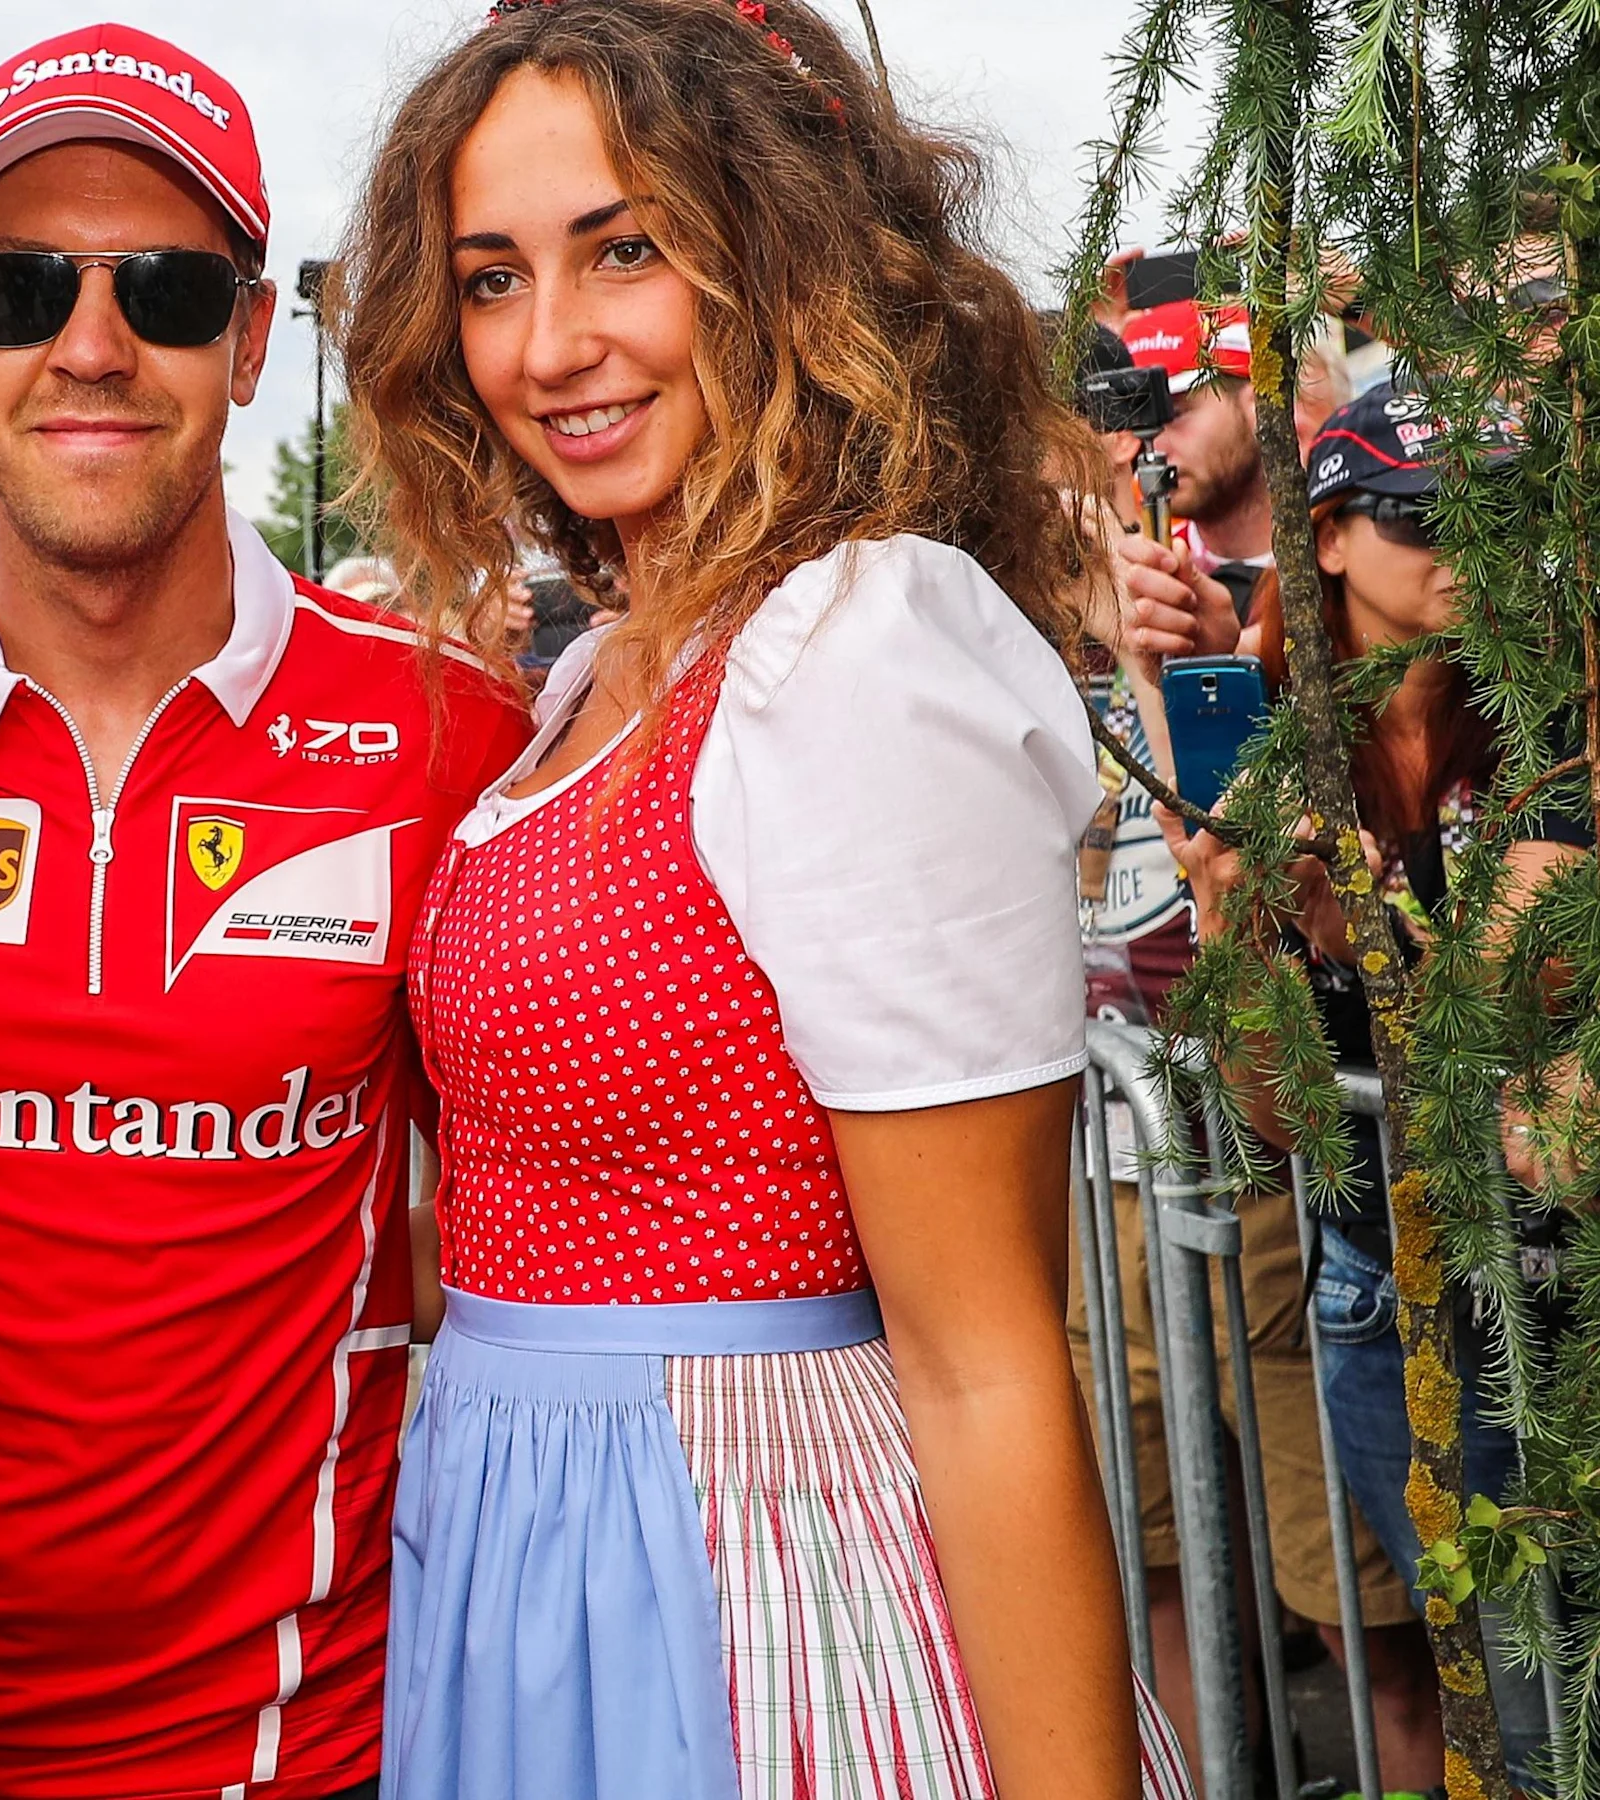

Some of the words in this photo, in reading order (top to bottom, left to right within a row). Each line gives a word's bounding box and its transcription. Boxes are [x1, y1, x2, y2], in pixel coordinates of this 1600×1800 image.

[10, 49, 232, 131] Santander
[1126, 330, 1184, 354] ander
[302, 718, 400, 755] 70
[301, 750, 399, 766] 1947-2017
[229, 913, 347, 930] SCUDERIA
[273, 930, 372, 947] FERRARI
